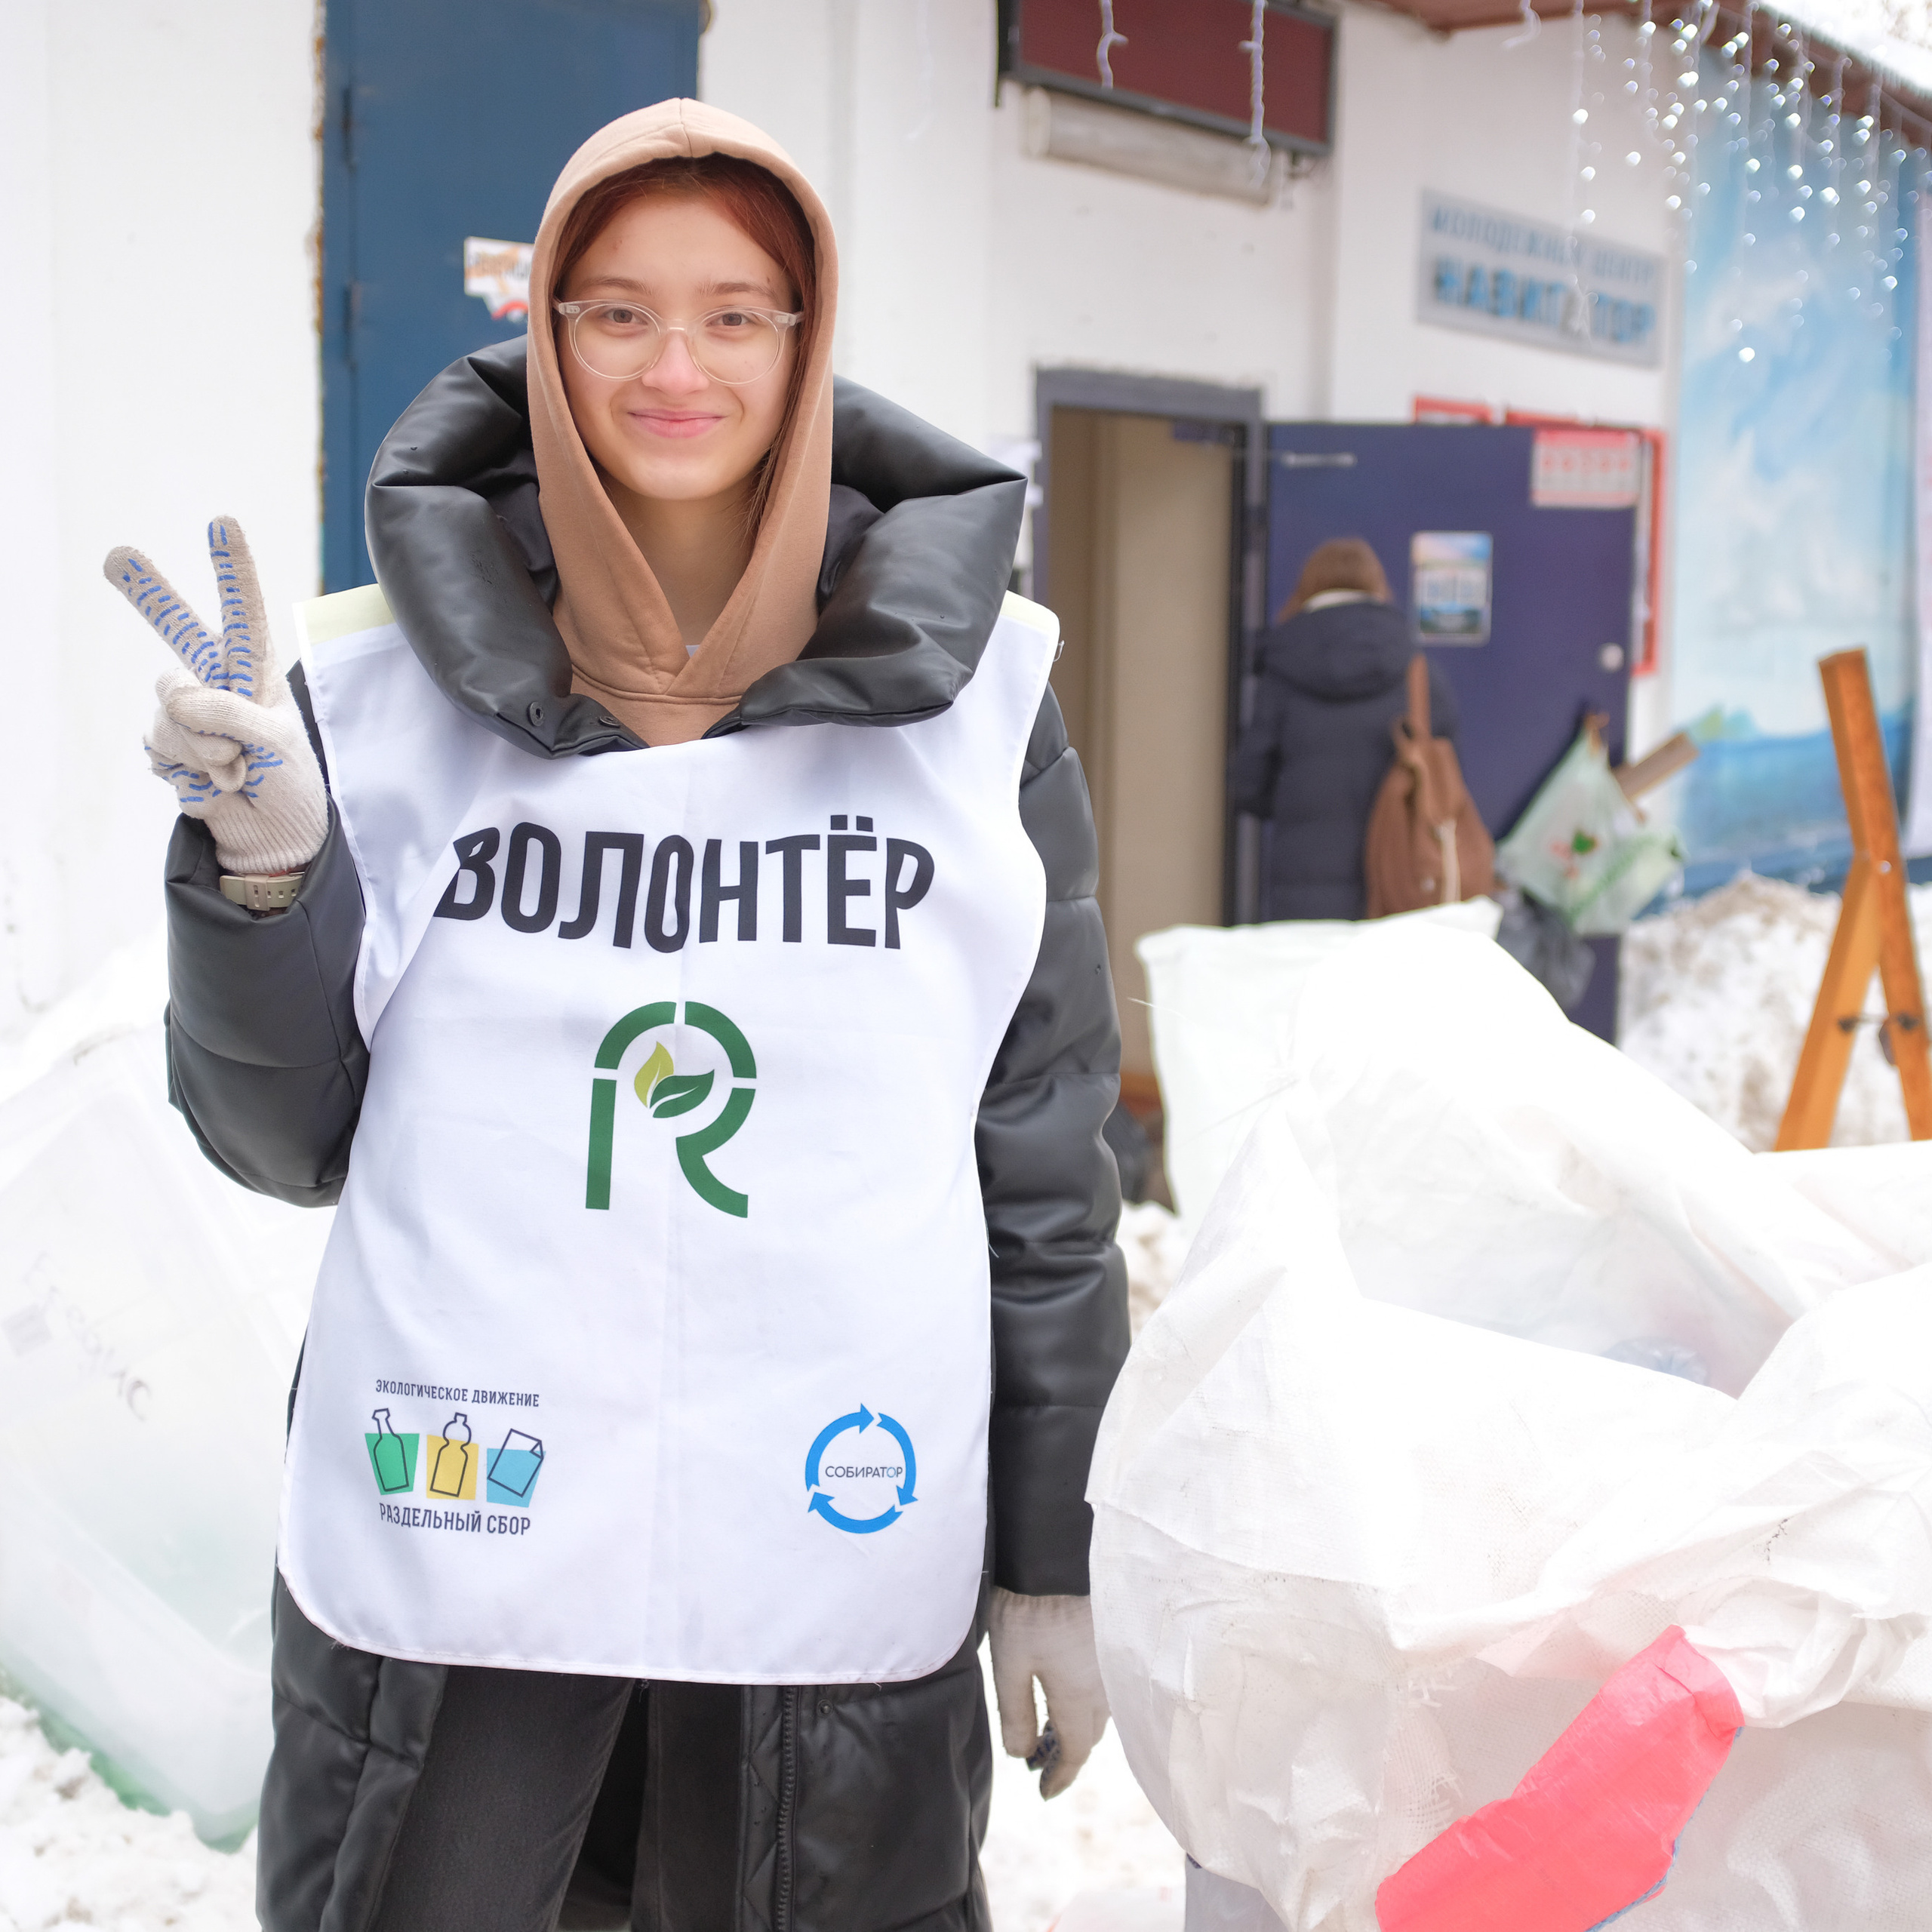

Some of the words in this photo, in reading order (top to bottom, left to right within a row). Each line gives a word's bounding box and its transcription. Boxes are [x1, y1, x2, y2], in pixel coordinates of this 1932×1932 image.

[432, 814, 935, 954] ВОЛОНТЁР
[375, 1379, 469, 1402] ЭКОЛОГИЧЕСКОЕ
[471, 1389, 540, 1407] ДВИЖЕНИЕ
[825, 1466, 903, 1478] СОБИРАТОР
[379, 1502, 482, 1533] РАЗДЕЛЬНЫЙ
[486, 1514, 531, 1536] СБОР
